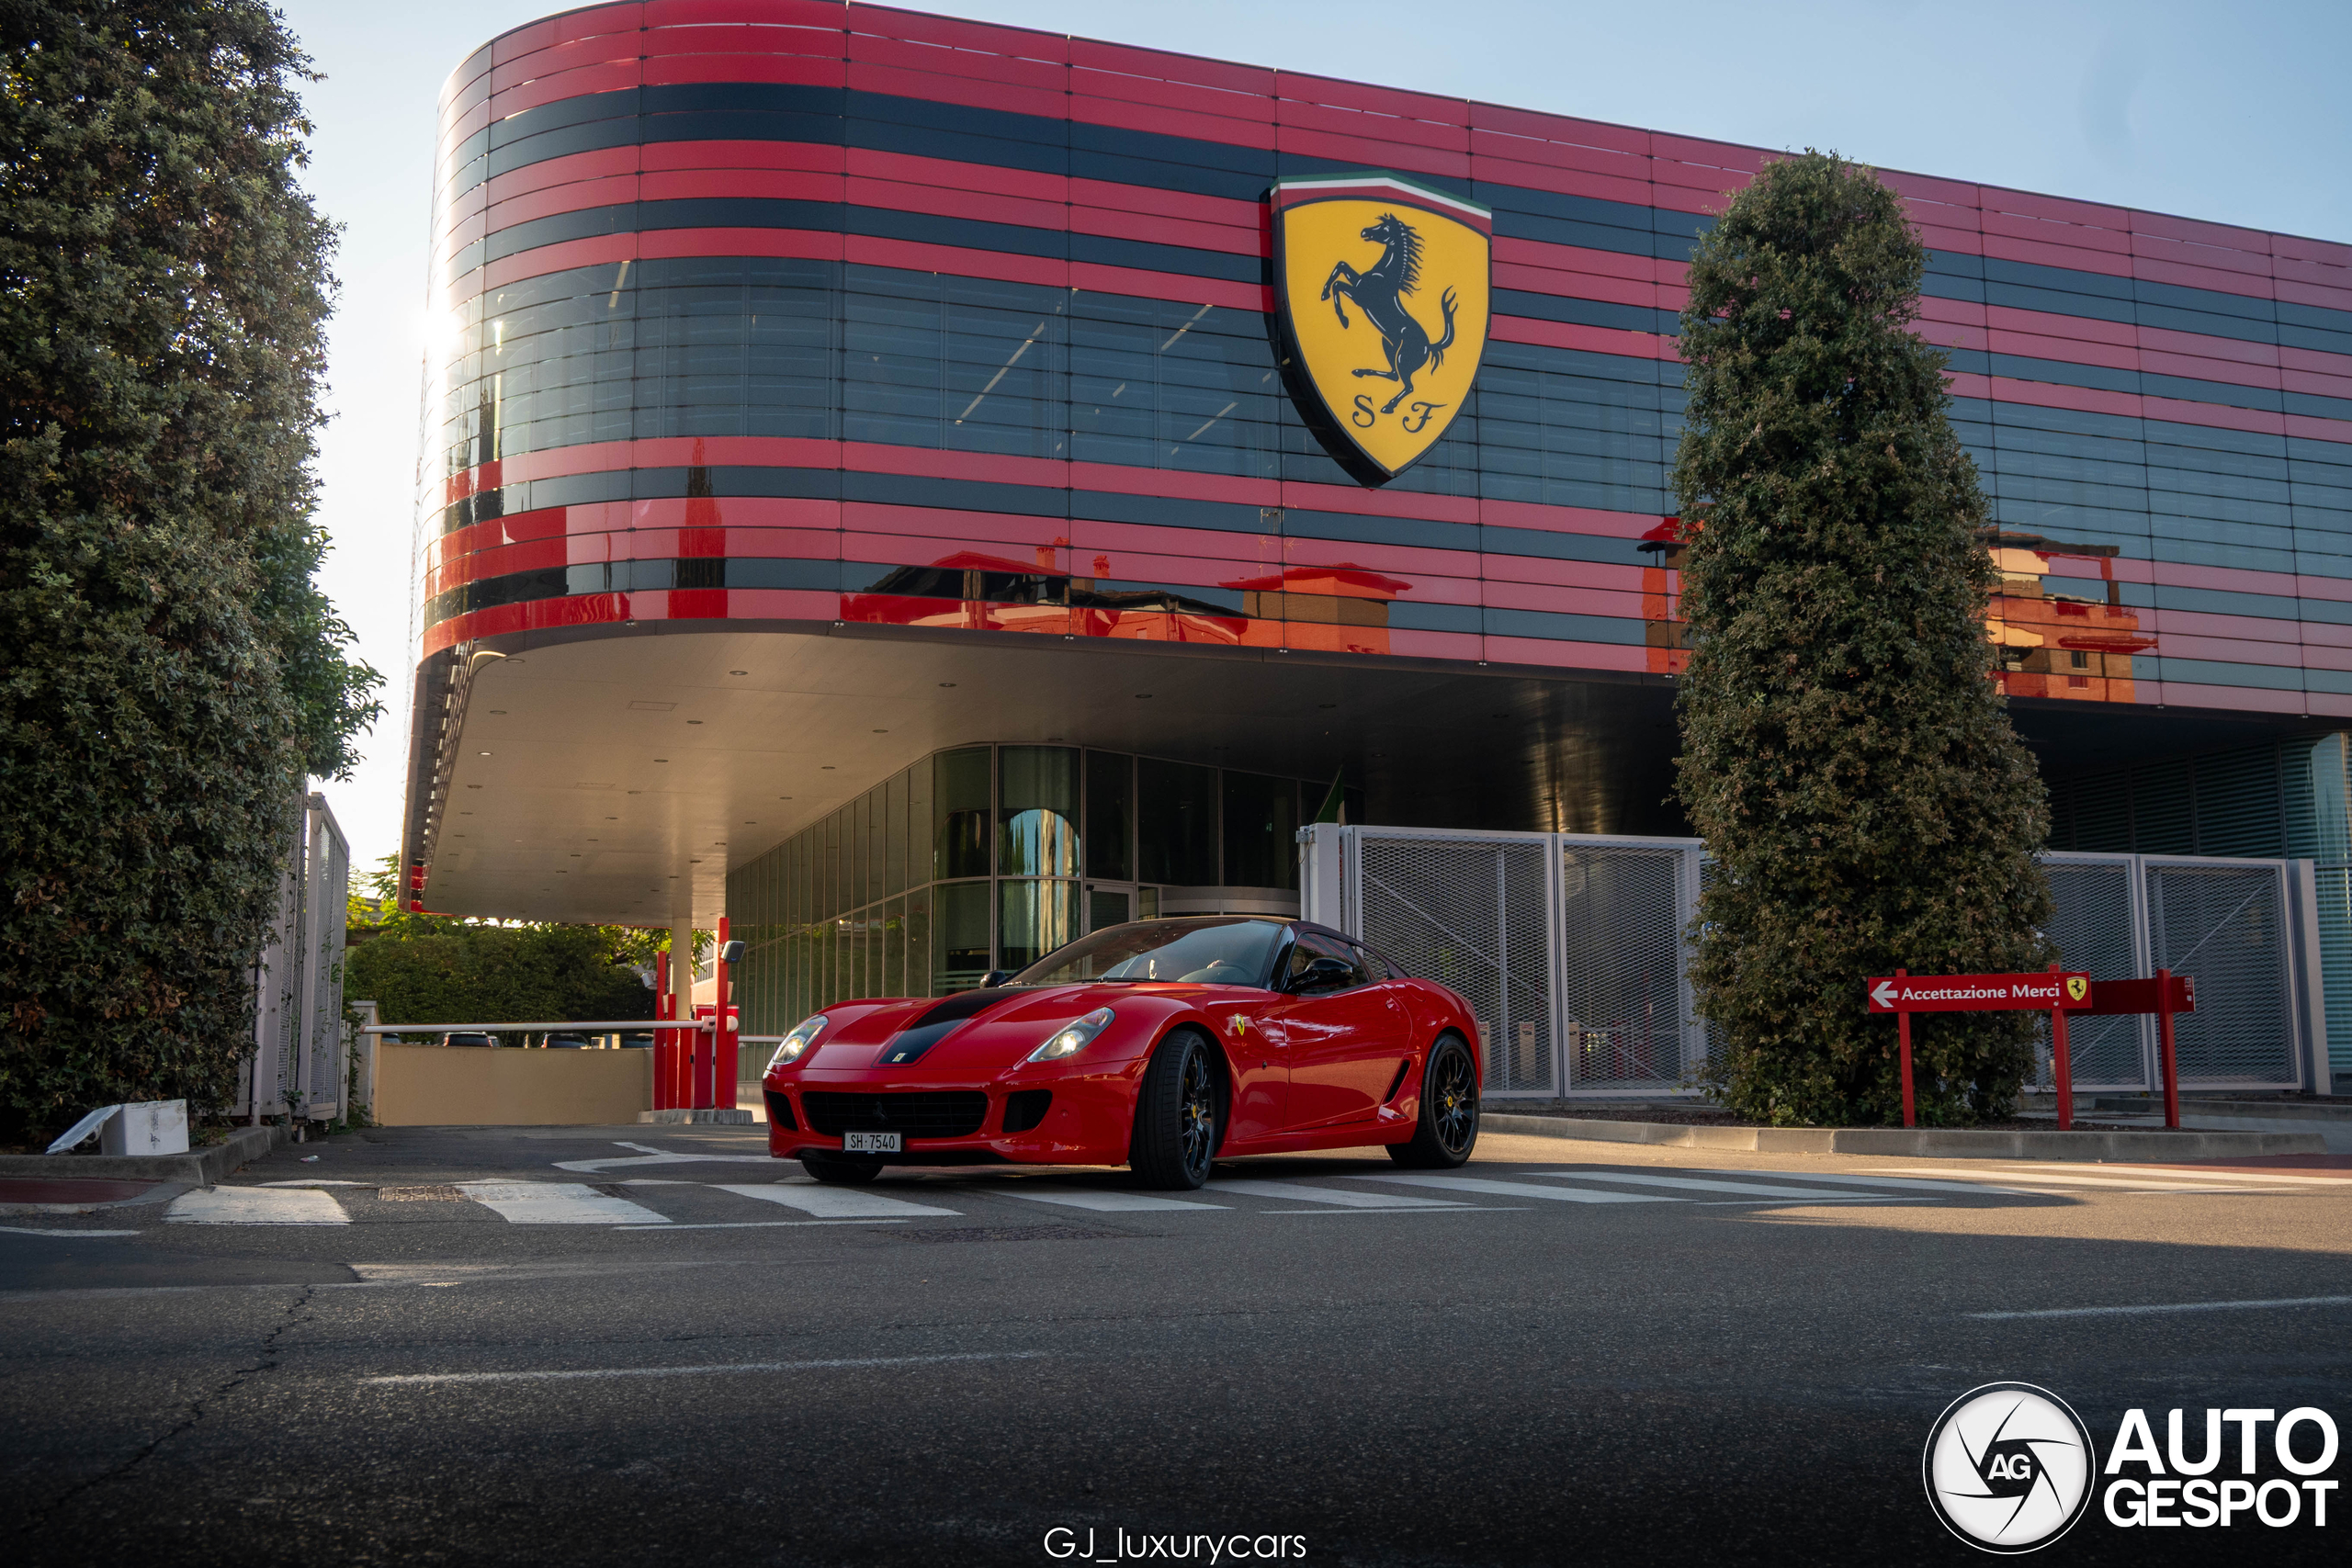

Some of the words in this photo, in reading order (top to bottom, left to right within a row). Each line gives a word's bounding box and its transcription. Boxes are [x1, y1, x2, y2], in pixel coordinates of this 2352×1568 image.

[1351, 394, 1375, 428] S
[1402, 400, 1448, 433] F
[1901, 984, 2007, 1000] Accettazione
[2012, 982, 2060, 998] Merci
